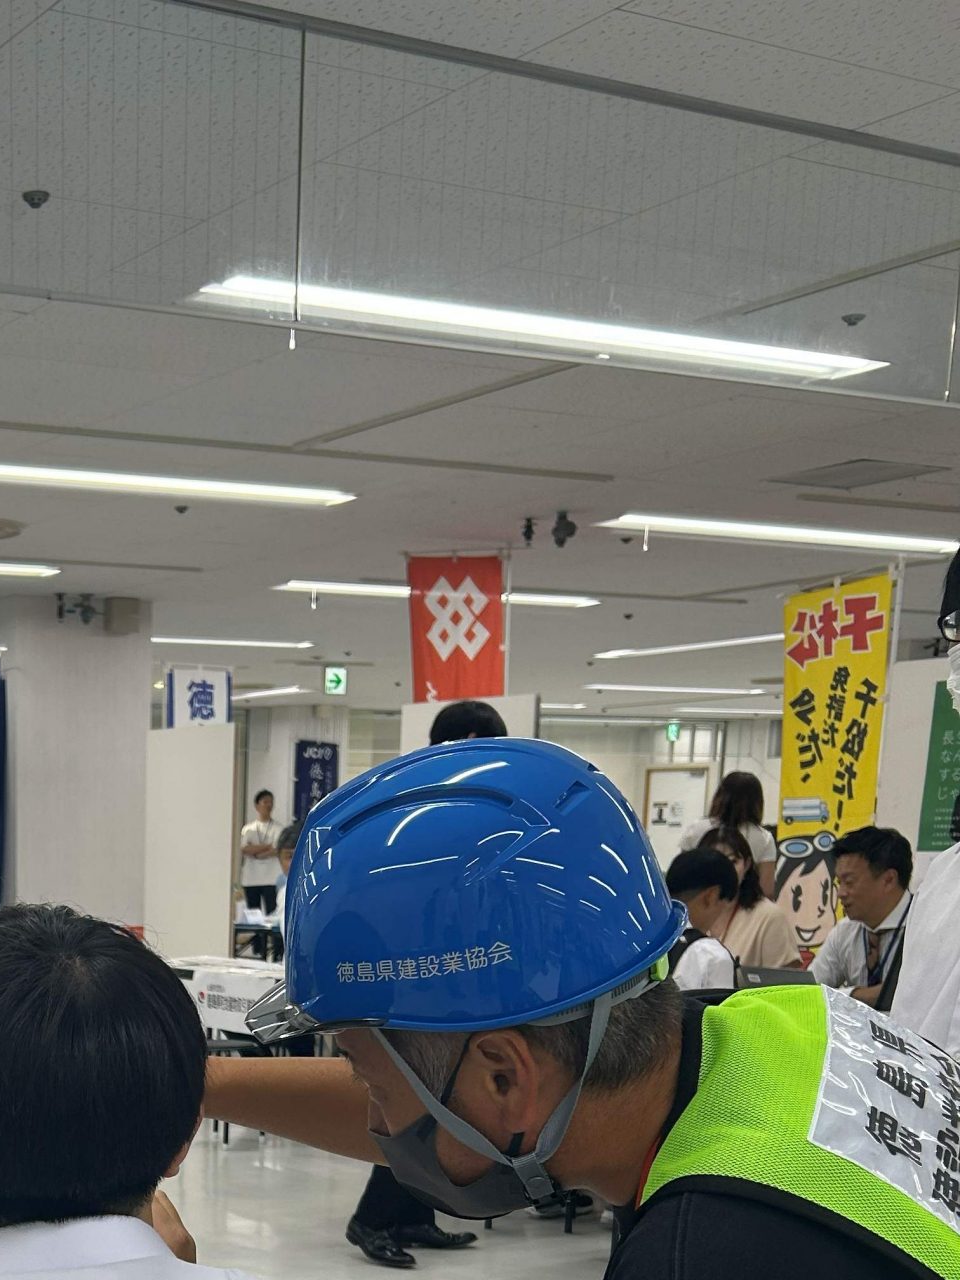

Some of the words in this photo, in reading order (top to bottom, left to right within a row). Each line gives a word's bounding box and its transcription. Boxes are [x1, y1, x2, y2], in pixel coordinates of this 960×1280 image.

[302, 747, 324, 759] JCI
[308, 762, 324, 807] 徳島
[335, 940, 513, 984] 徳島県建設業協会
[864, 1019, 929, 1167] 徳島県
